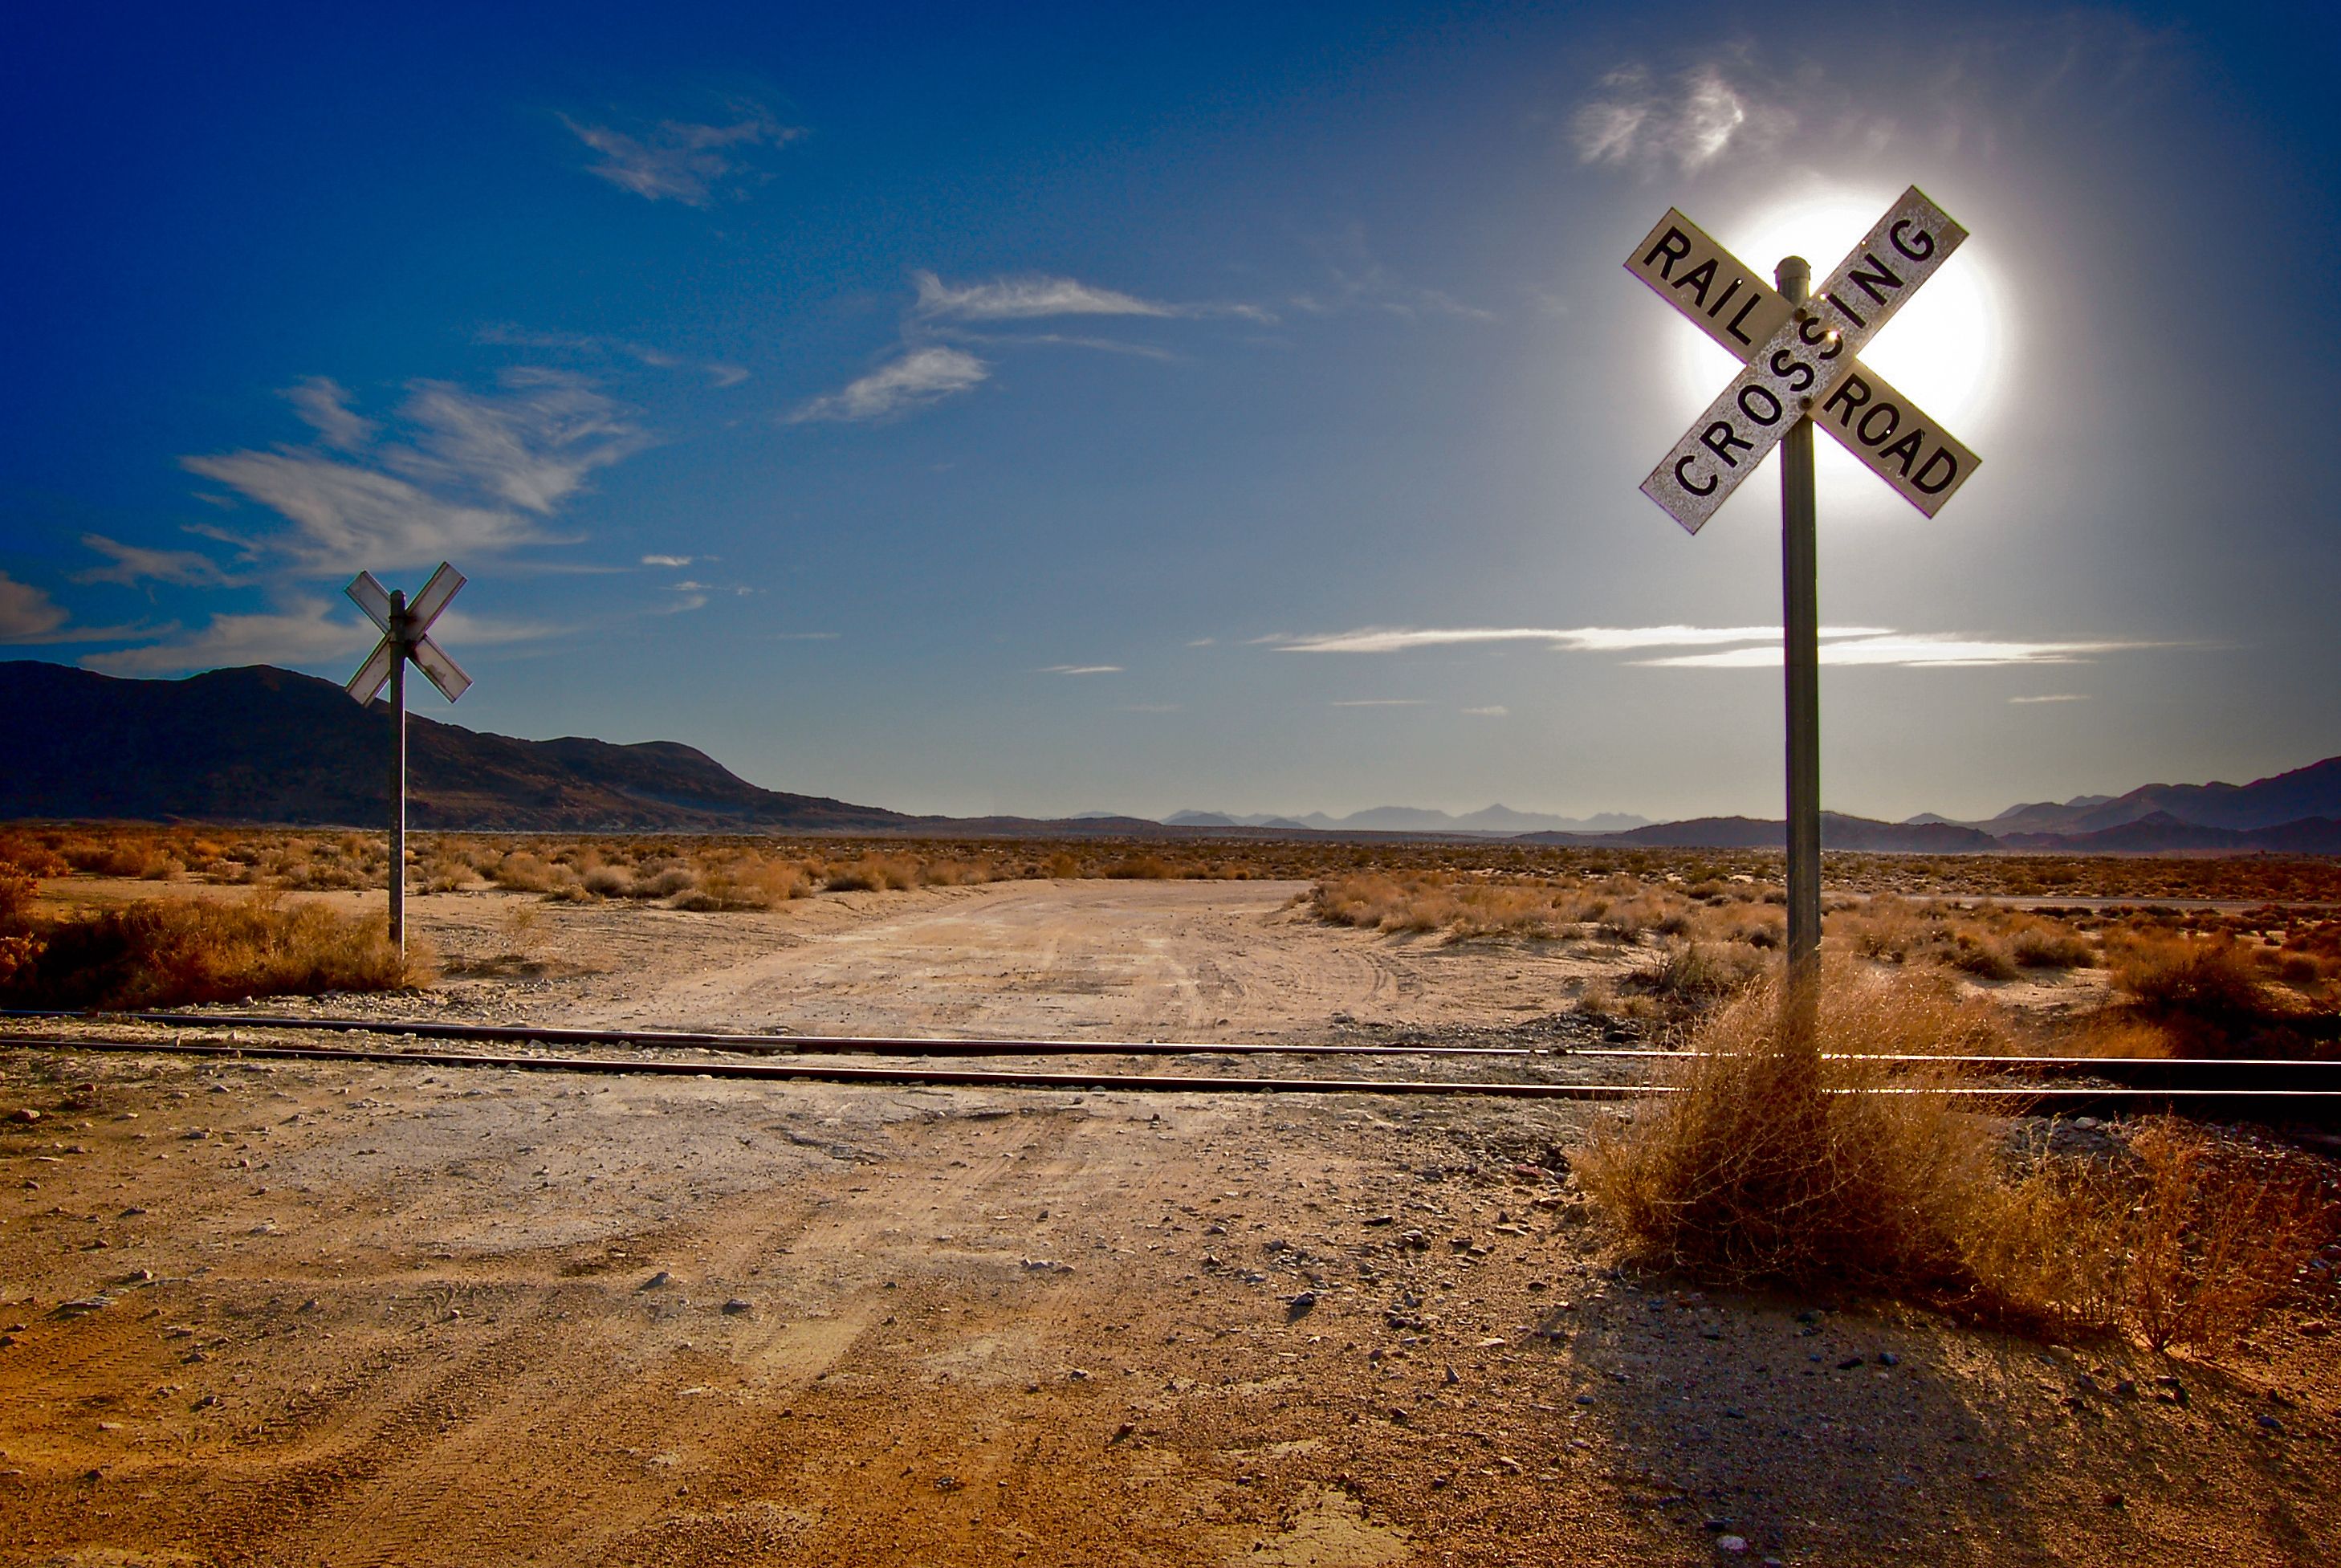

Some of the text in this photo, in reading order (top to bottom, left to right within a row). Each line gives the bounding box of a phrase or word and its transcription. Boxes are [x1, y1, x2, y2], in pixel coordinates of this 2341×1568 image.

[1643, 226, 1958, 495] RAIL ROAD
[1674, 219, 1936, 497] CROSSING
